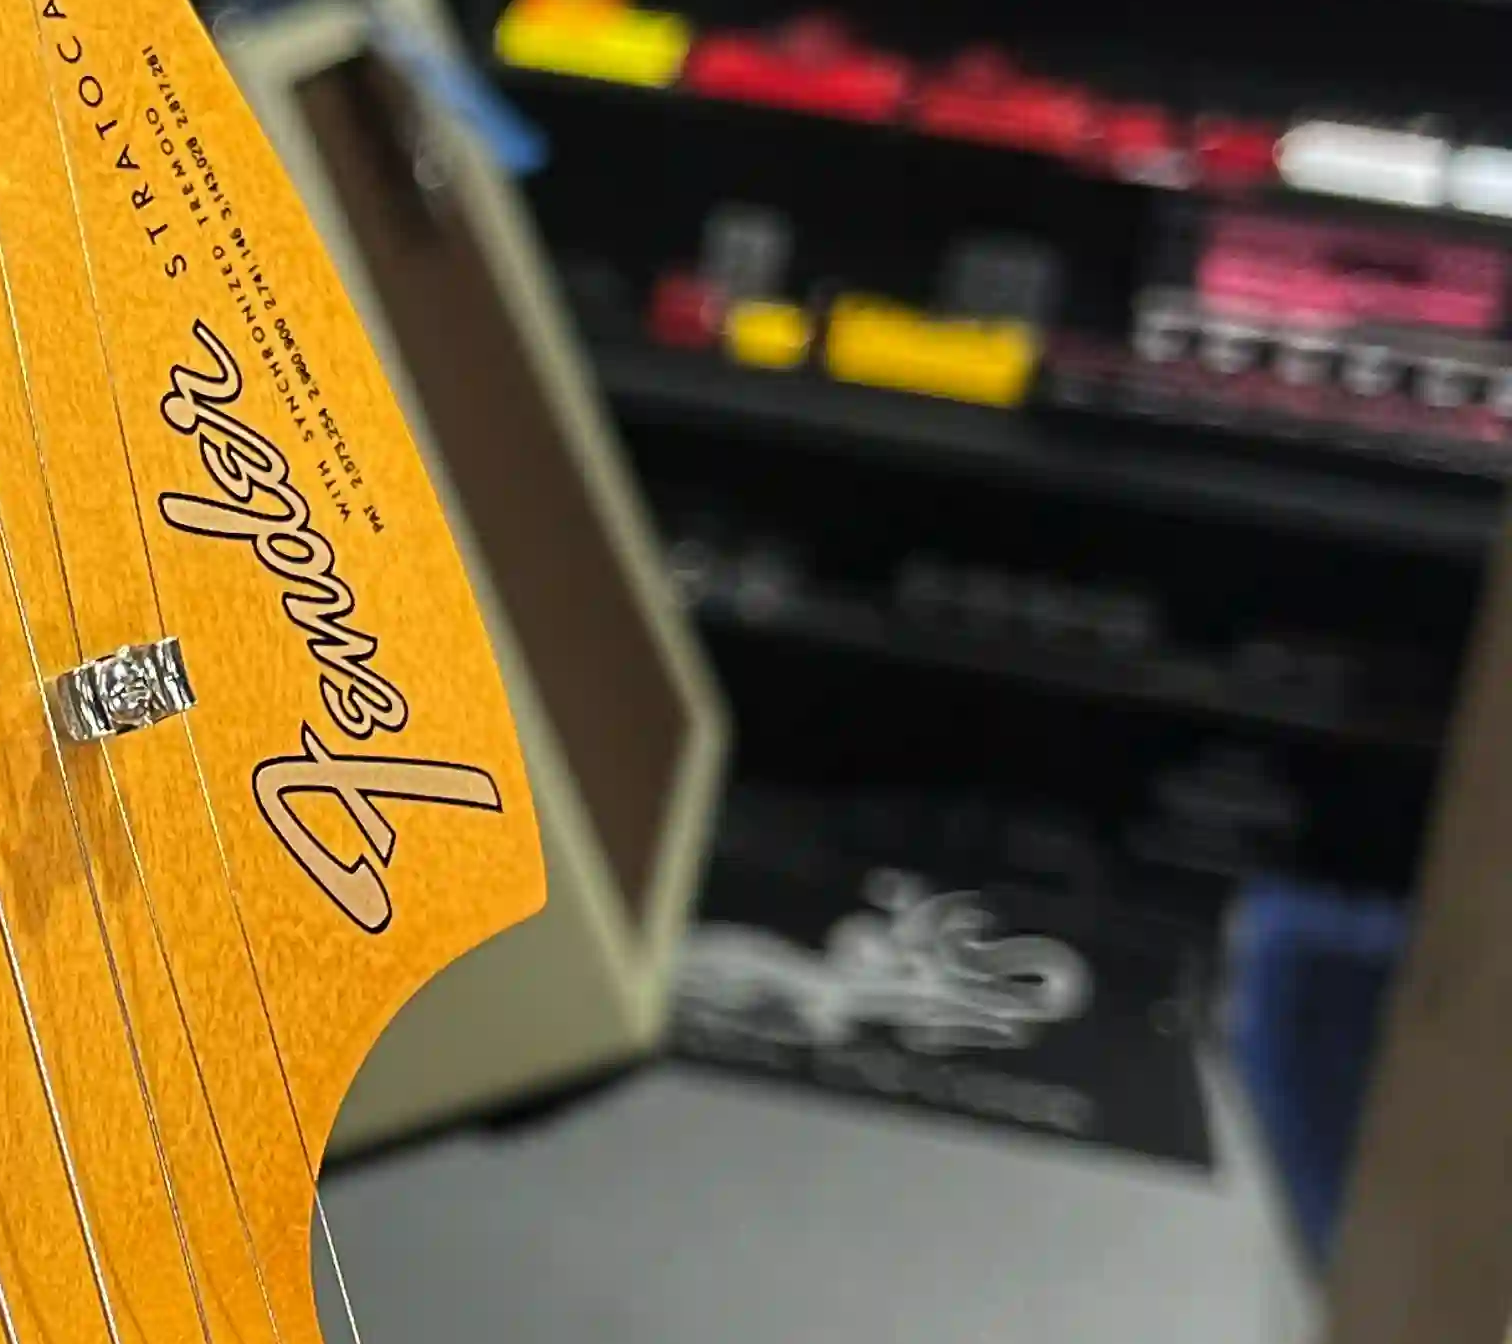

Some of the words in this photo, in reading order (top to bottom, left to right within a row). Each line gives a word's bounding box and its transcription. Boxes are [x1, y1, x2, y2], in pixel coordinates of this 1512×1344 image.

[145, 107, 210, 227] TREMOLO
[212, 245, 314, 443] SYNCHRONIZED
[317, 459, 351, 523] WITH
[159, 318, 504, 935] Fender
